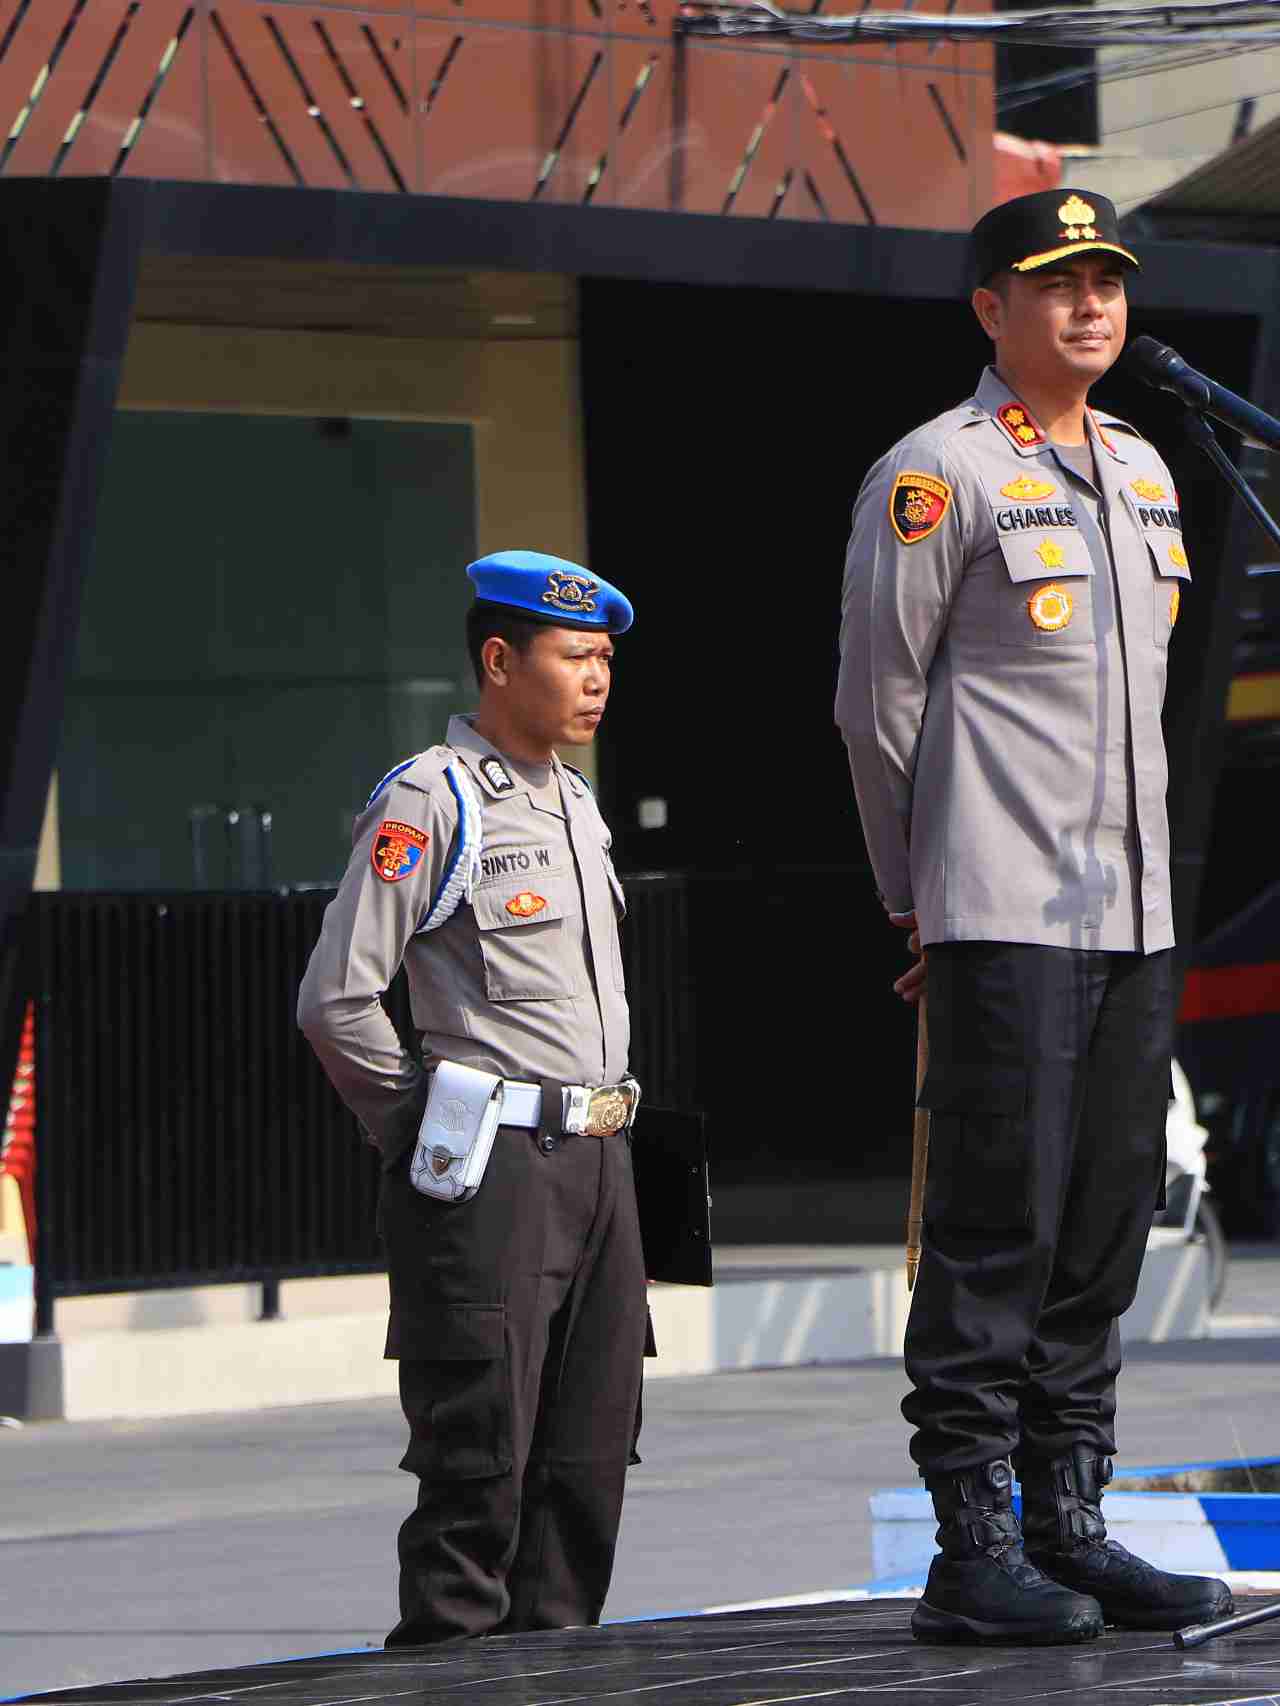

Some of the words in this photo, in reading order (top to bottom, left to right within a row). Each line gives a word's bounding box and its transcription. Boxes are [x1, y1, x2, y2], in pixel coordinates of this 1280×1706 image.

[997, 507, 1078, 531] CHARLES
[385, 822, 425, 842] PROPAM
[534, 849, 551, 867] W
